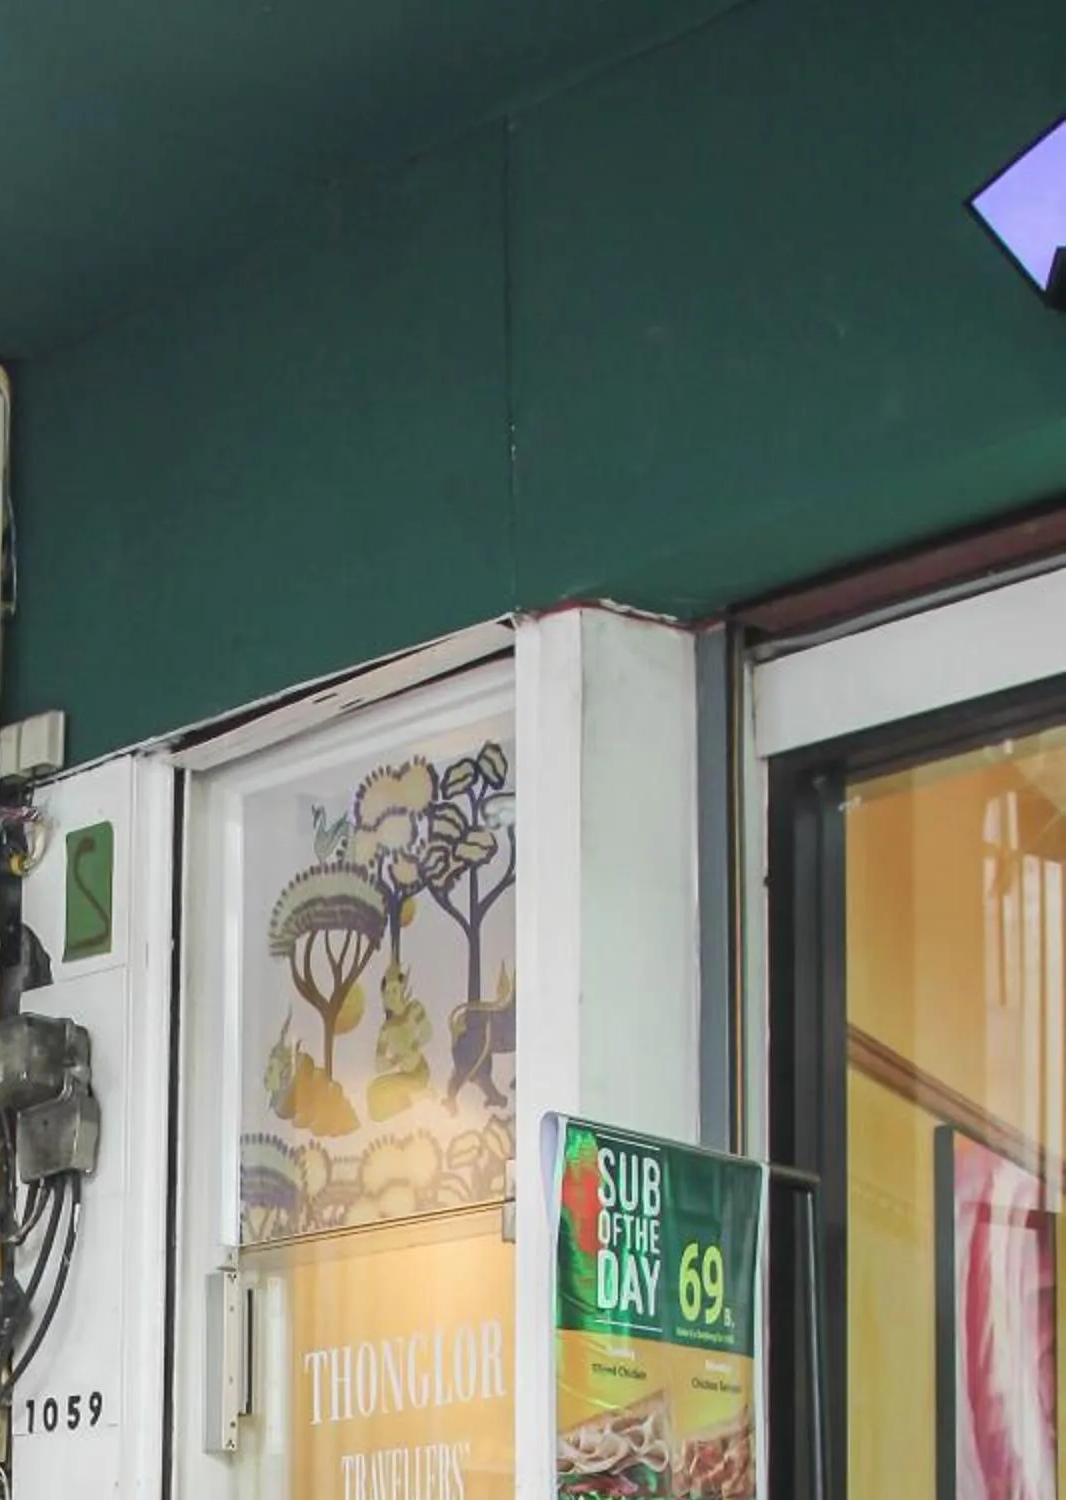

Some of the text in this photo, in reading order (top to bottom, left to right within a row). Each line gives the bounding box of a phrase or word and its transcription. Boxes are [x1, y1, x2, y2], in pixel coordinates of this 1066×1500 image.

[597, 1147, 661, 1217] SUB
[597, 1209, 660, 1254] OF THE
[597, 1249, 661, 1318] DAY
[678, 1242, 724, 1325] 69
[304, 1318, 507, 1425] THONGLOR
[26, 1391, 103, 1434] 1059
